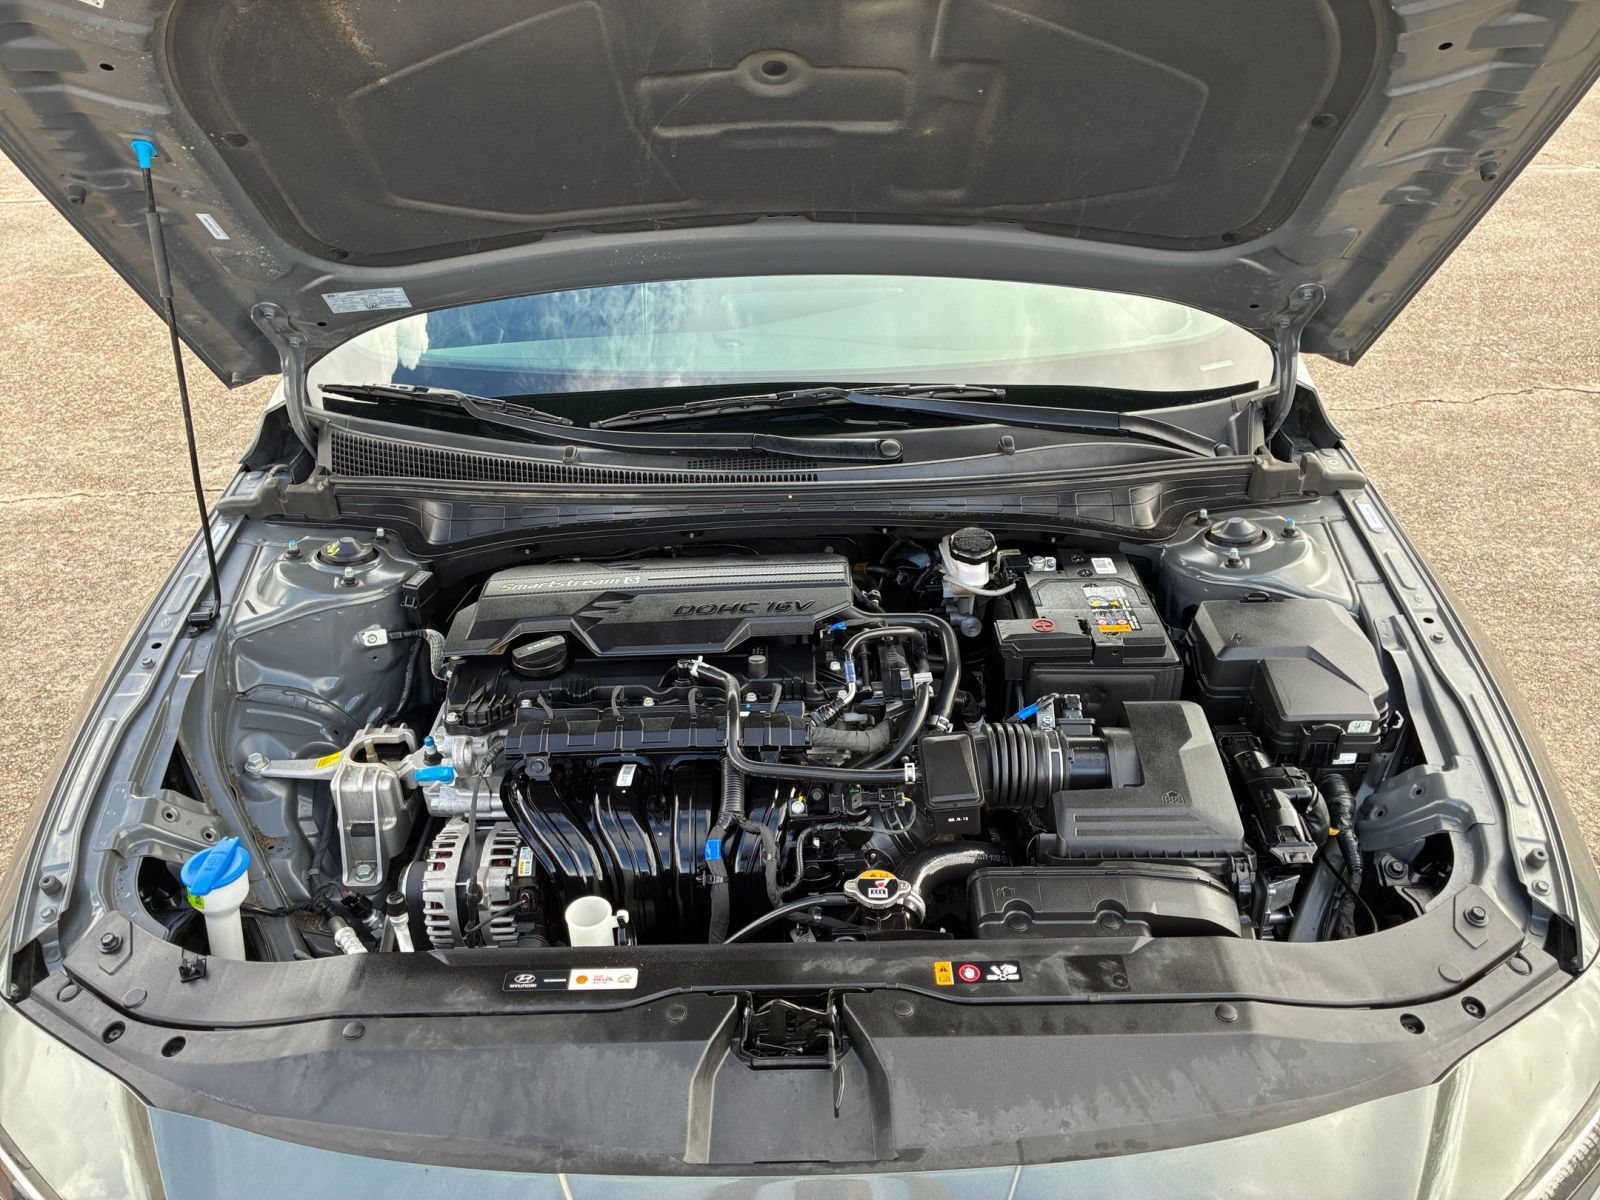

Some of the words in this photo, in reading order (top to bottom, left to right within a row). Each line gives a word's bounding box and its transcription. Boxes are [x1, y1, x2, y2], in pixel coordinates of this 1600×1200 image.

[502, 579, 621, 591] Smartstream
[672, 602, 759, 617] DOHC
[766, 599, 817, 614] 16V
